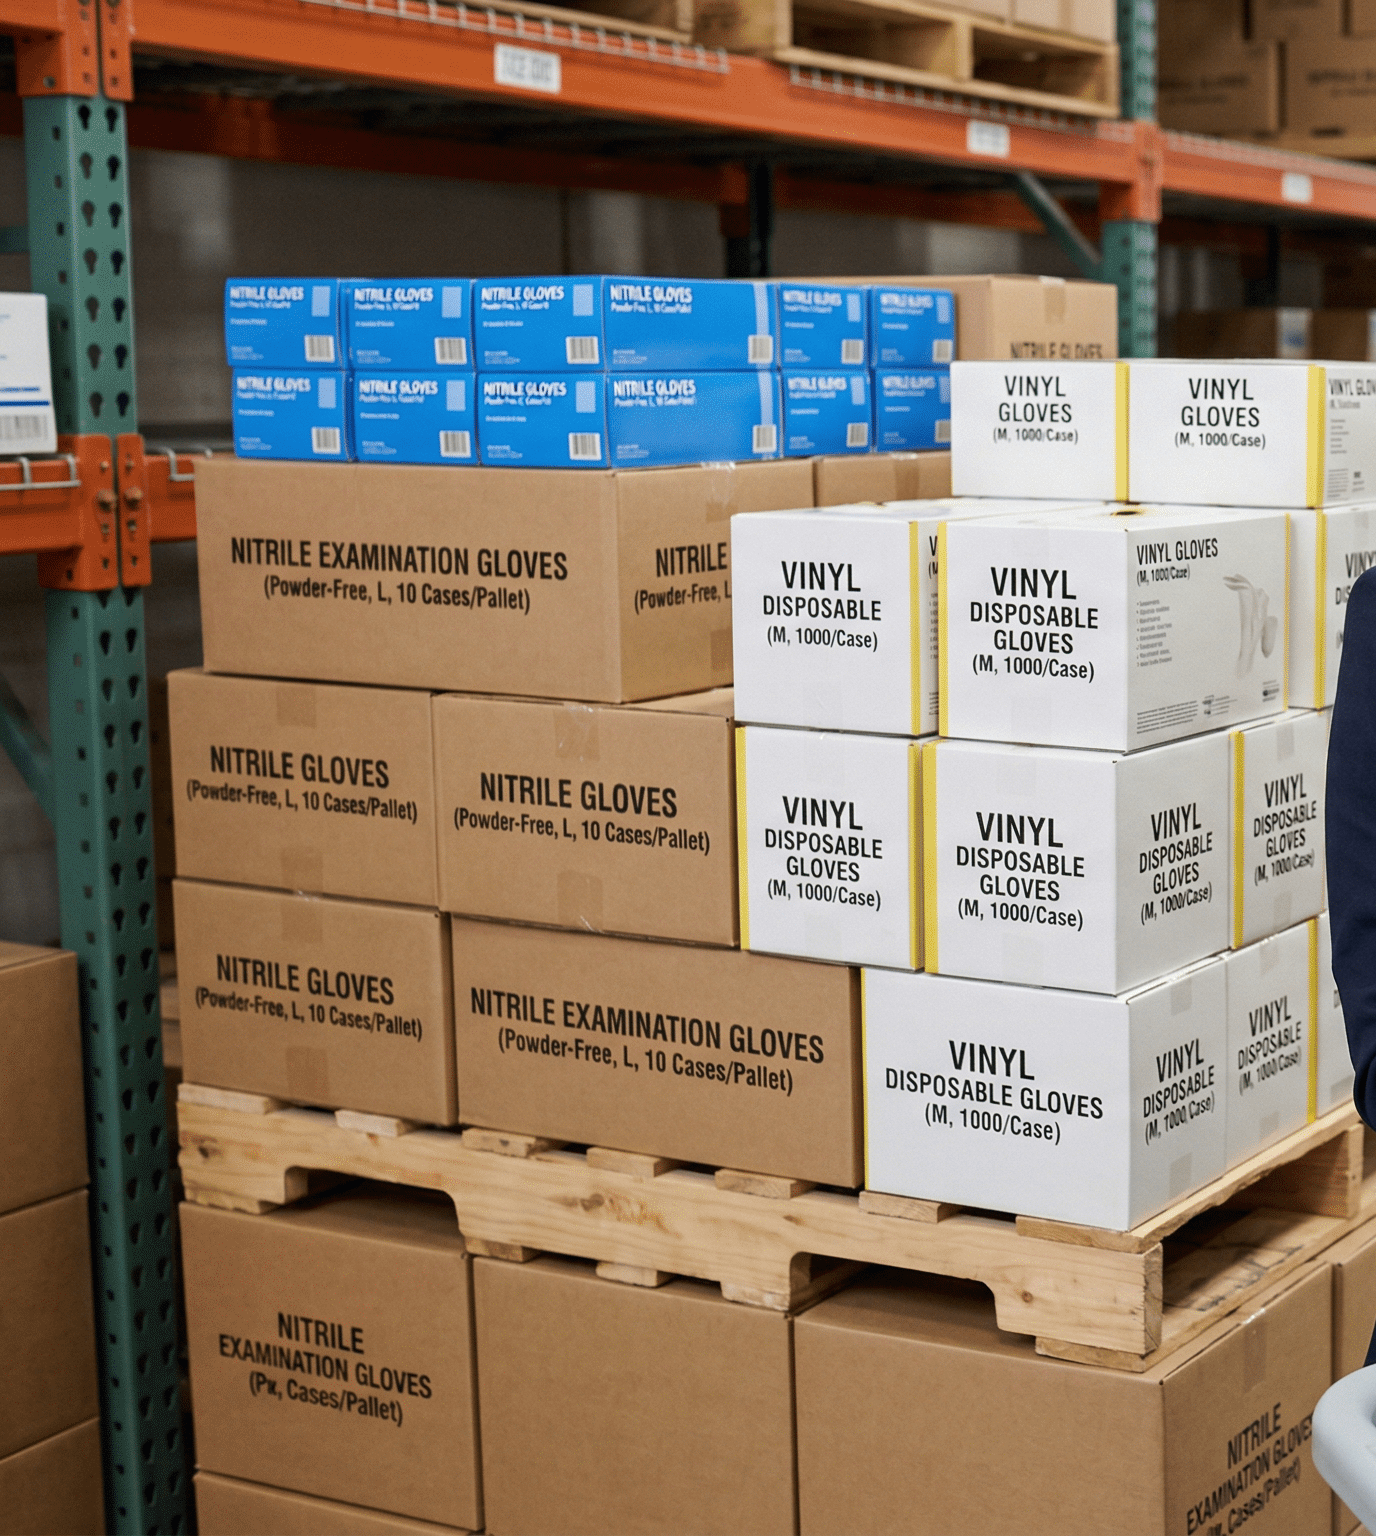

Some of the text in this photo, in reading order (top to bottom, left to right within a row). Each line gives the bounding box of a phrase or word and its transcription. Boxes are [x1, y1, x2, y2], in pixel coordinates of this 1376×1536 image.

[610, 285, 692, 303] NITRILE GLOVES
[614, 380, 696, 397] NITRILE GLOVES
[1004, 376, 1066, 397] VINYL
[1189, 378, 1254, 401] VINYL
[998, 402, 1072, 423] GLOVES
[1181, 407, 1260, 428] GLOVES
[1016, 427, 1078, 445] 1000/Case)
[1174, 432, 1266, 451] (M, 1000/Case)
[231, 537, 568, 581] NITRILE EXAMINATION GLOVES
[656, 542, 727, 578] NITRILE
[1137, 538, 1219, 565] VINYL GLOVES
[781, 561, 861, 592] VINYL
[990, 566, 1077, 600] VINYL
[264, 574, 530, 615] (Powder-Free, L, 10 Cases/Pallet)
[634, 582, 722, 615] (Powder-Free,
[763, 595, 882, 621] DISPOSABLE
[970, 602, 1099, 629] DISPOSABLE
[767, 626, 878, 652] (M, 1000/Case)
[993, 629, 1073, 654] GLOVES
[972, 654, 1095, 683] (M, 1000/Case)
[210, 746, 389, 789] NITRILE GLOVES
[187, 779, 417, 825] (Powder-Free, L, 10 Cases/Pallet)
[480, 772, 677, 819] NITRILE GLOVES
[1264, 773, 1307, 808] VINYL
[782, 796, 863, 831] VINYL
[976, 812, 1064, 848] VINYL
[1151, 802, 1201, 842] VINYL
[1253, 801, 1317, 838] DISPOSABLE
[454, 807, 711, 856] (Powder-Free, L, 10 Cases/Pallet)
[765, 828, 883, 860] DISPOSABLE
[1266, 826, 1306, 858] GLOVES
[786, 855, 860, 883] GLOVES
[956, 846, 1085, 878] DISPOSABLE
[1139, 832, 1213, 874] DISPOSABLE
[767, 879, 882, 912] (M, 1000/Case)
[980, 874, 1060, 902] GLOVES
[1153, 862, 1199, 895] GLOVES
[958, 898, 1084, 931] (M, 1000/Case)
[1141, 902, 1158, 925] (M,
[216, 954, 394, 1006] NITRILE GLOVES
[194, 986, 423, 1043] (Powder-Free, L, 10 Cases/Pallet)
[471, 986, 824, 1065] NITRILE EXAMINATION GLOVES
[1249, 995, 1292, 1037] VINYL
[498, 1026, 794, 1097] (Powder-Free, L, 10 Cases/Pallet)
[949, 1040, 1035, 1080] VINYL
[1156, 1037, 1205, 1084] VINYL
[1237, 1020, 1302, 1071] DISPOSABLE
[885, 1068, 1103, 1119] DISPOSABLE GLOVES
[1143, 1065, 1215, 1119] DISPOSABLE
[925, 1102, 1061, 1145] (M, 1000/Case)
[1145, 1121, 1161, 1146] (M,
[277, 1312, 364, 1354] NITRILE
[219, 1333, 432, 1399] EXAMINATION GLOVES
[287, 1378, 403, 1427] Cases/Pallet)
[1227, 1402, 1281, 1469] NITRILE
[1187, 1447, 1270, 1536] EXAMINATION
